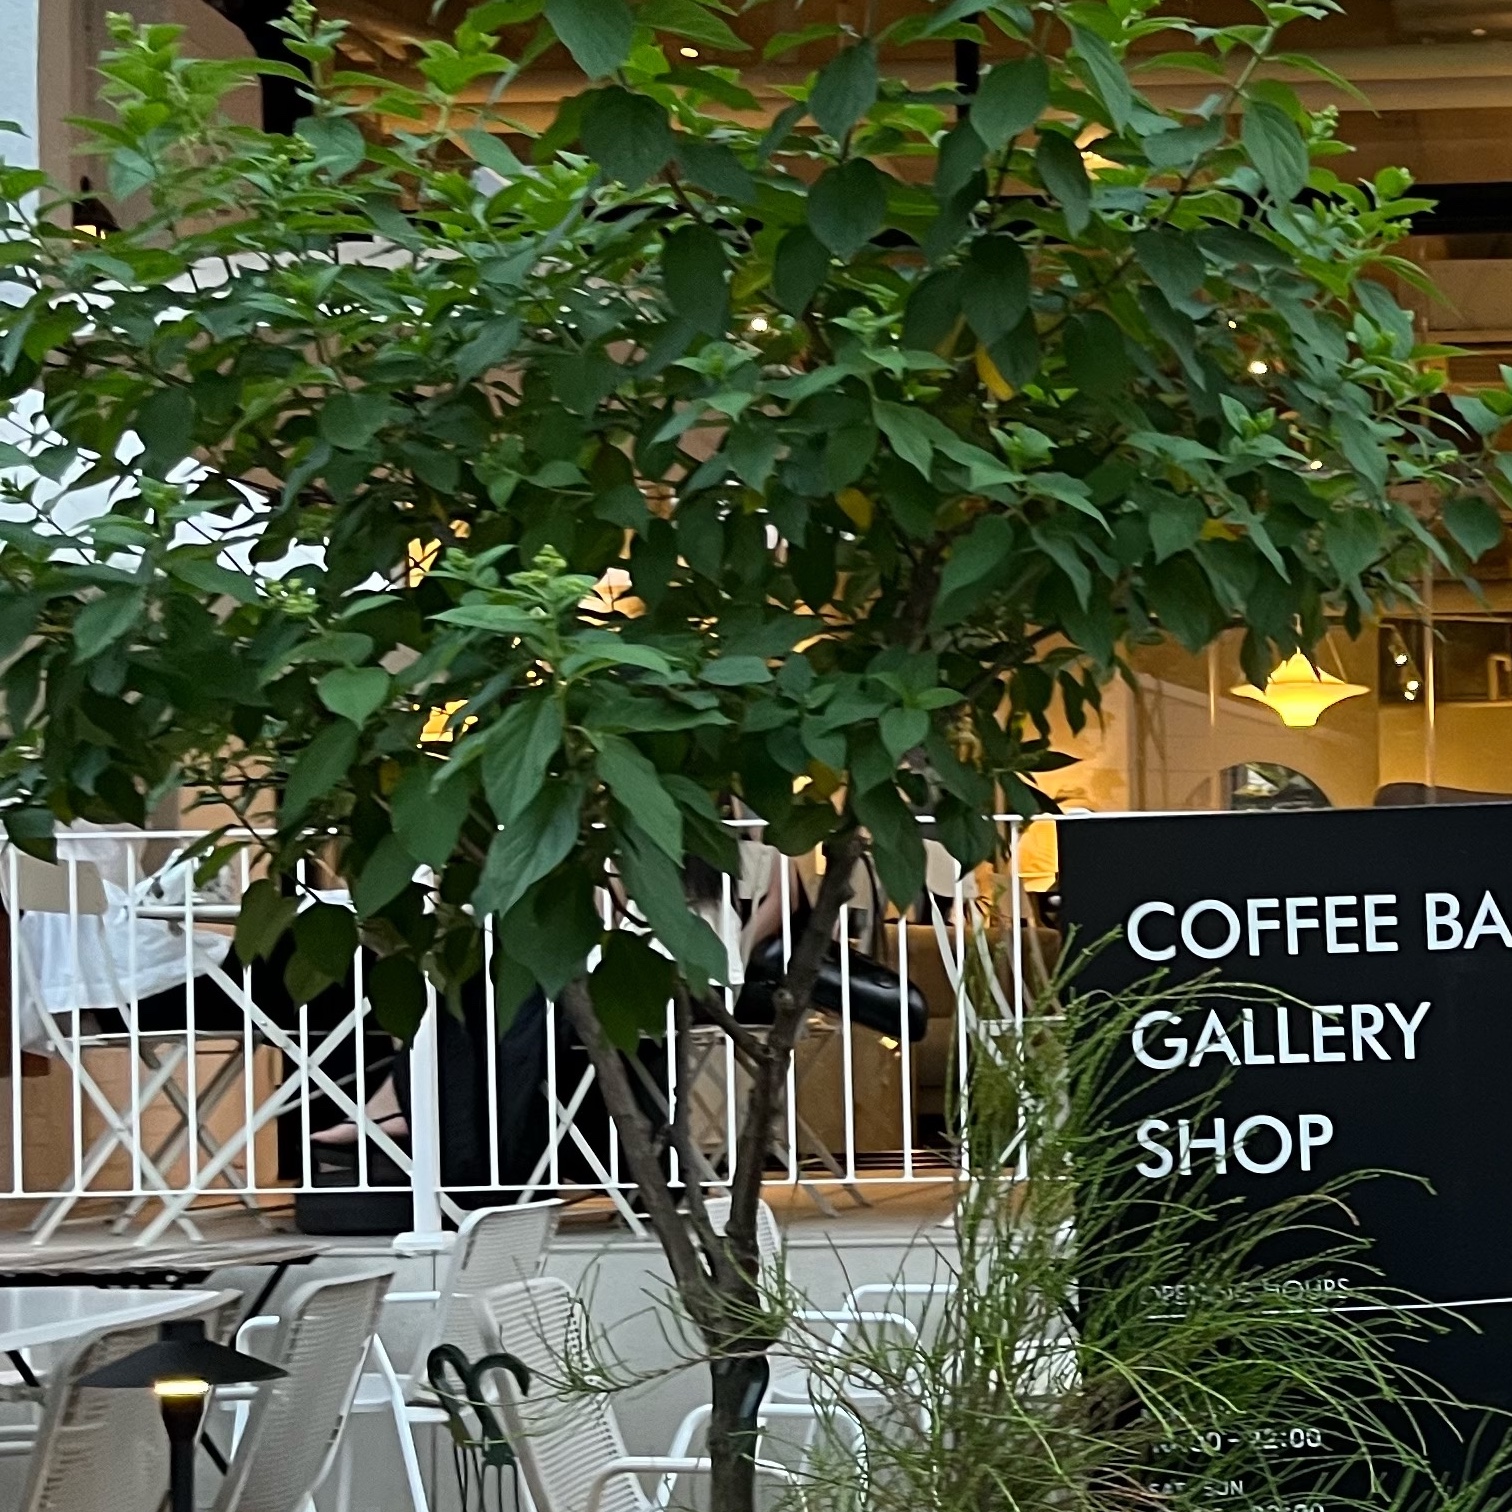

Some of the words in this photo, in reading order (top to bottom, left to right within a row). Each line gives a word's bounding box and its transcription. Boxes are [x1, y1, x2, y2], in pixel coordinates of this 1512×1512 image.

[1127, 894, 1399, 961] COFFEE
[1131, 1001, 1431, 1070] GALLERY
[1135, 1114, 1334, 1179] SHOP
[1140, 1284, 1250, 1305] OPENG
